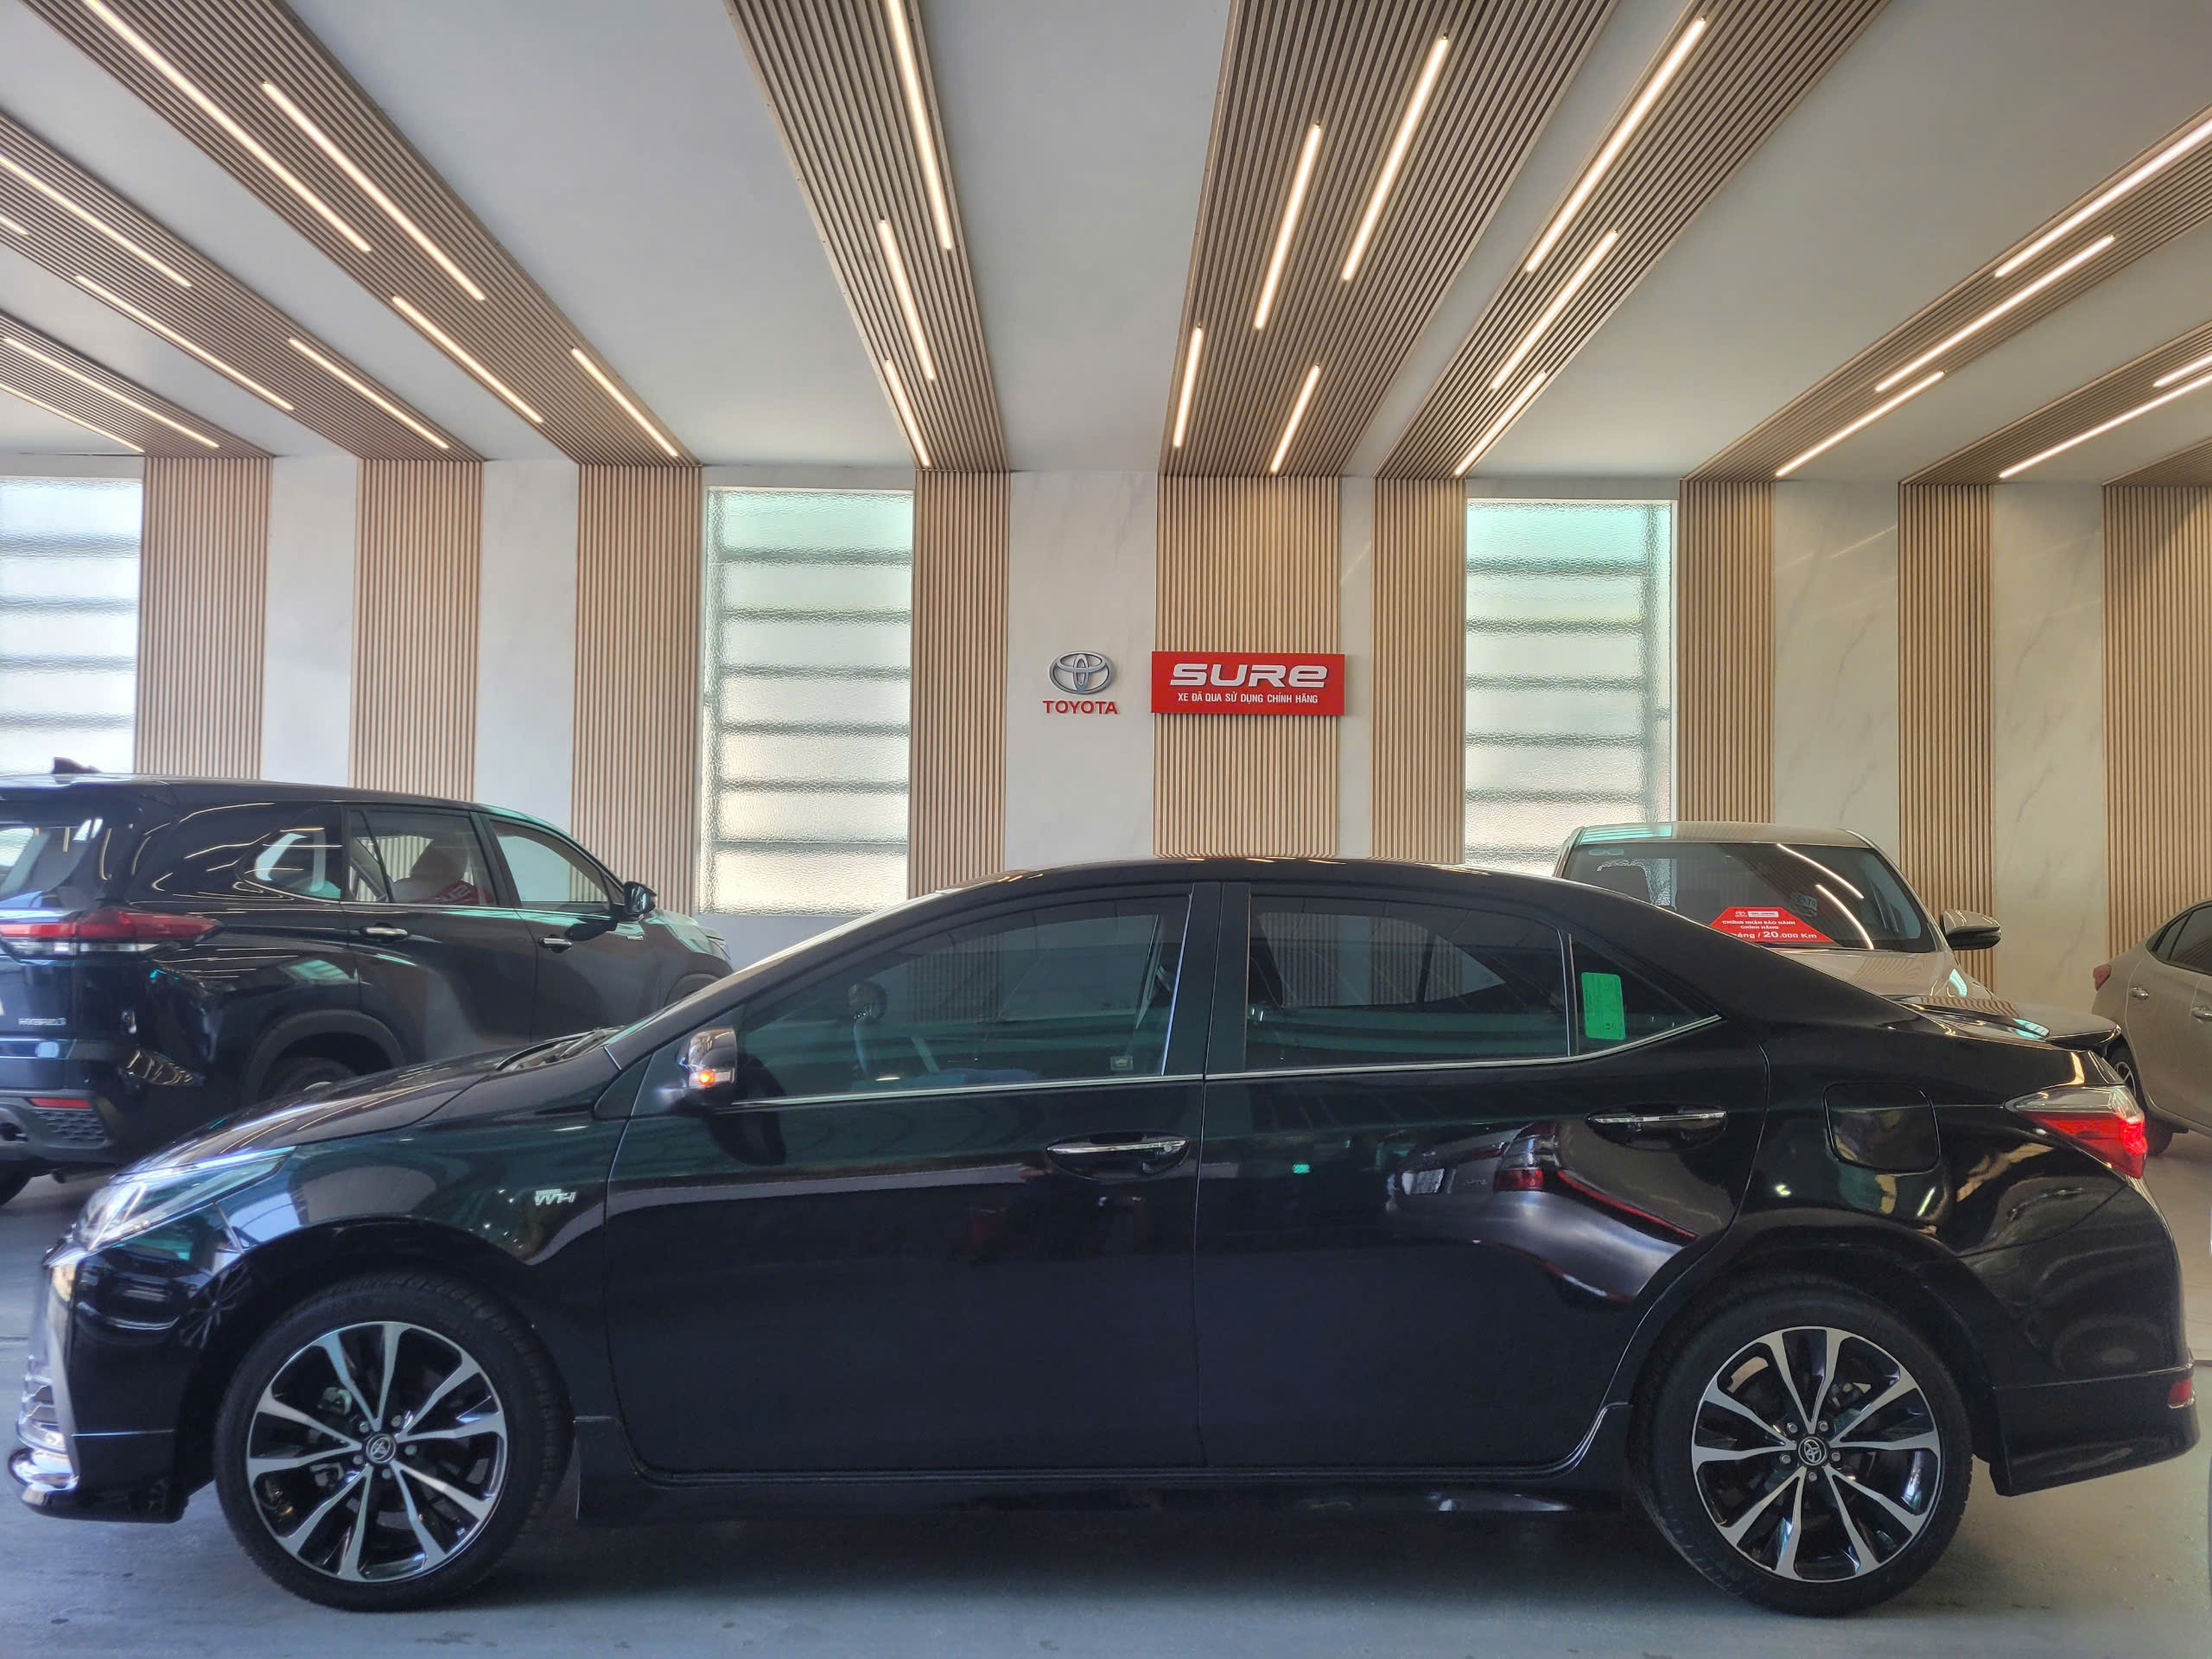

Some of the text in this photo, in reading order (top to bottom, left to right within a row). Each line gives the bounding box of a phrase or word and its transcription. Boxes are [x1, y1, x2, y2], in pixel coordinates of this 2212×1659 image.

[1178, 693, 1188, 702] XE
[1192, 691, 1203, 702] ĐÃ
[1205, 693, 1222, 702] QUA
[1225, 691, 1237, 702] SỬ
[1241, 693, 1263, 704] DỤNG
[1267, 692, 1293, 703] CHÍNH
[1042, 700, 1118, 715] TOYOTA
